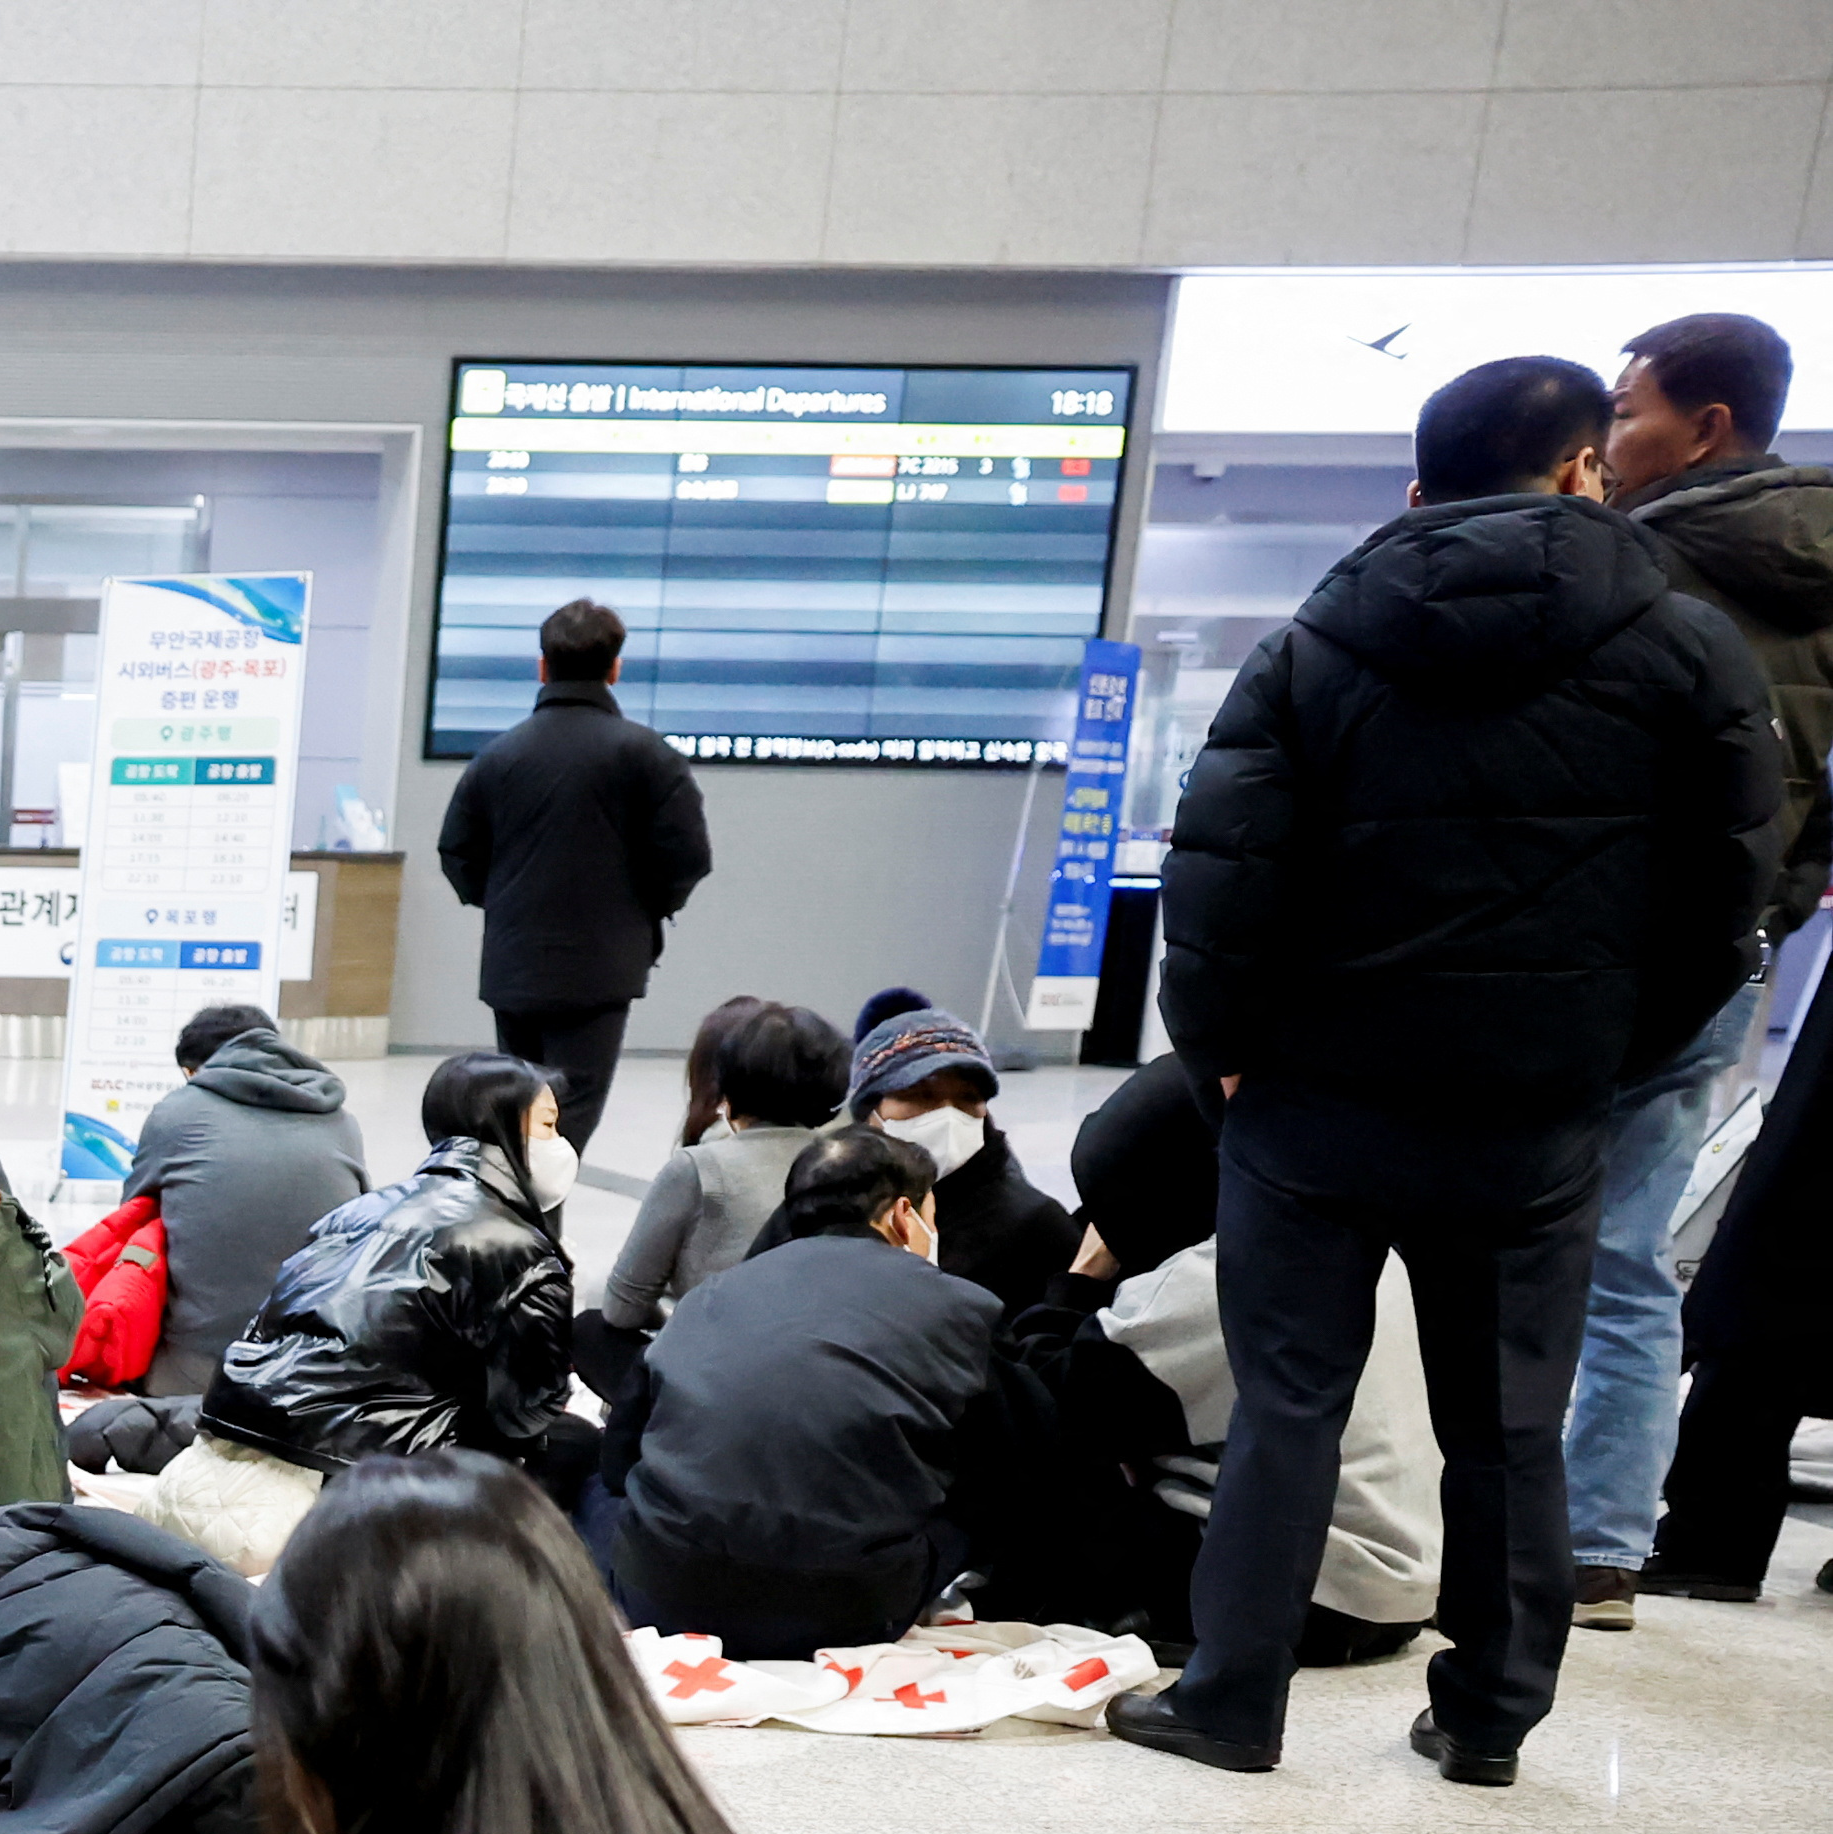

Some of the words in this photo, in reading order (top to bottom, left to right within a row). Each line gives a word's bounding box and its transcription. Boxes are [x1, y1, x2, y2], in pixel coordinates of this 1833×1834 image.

[505, 383, 568, 412] 국제선
[569, 382, 614, 413] 출발
[629, 385, 765, 412] International
[766, 387, 887, 417] Departures
[1051, 390, 1114, 416] 18:18
[149, 629, 260, 651] 무안국제공항
[161, 690, 196, 710] 증편
[203, 689, 239, 710] 운행
